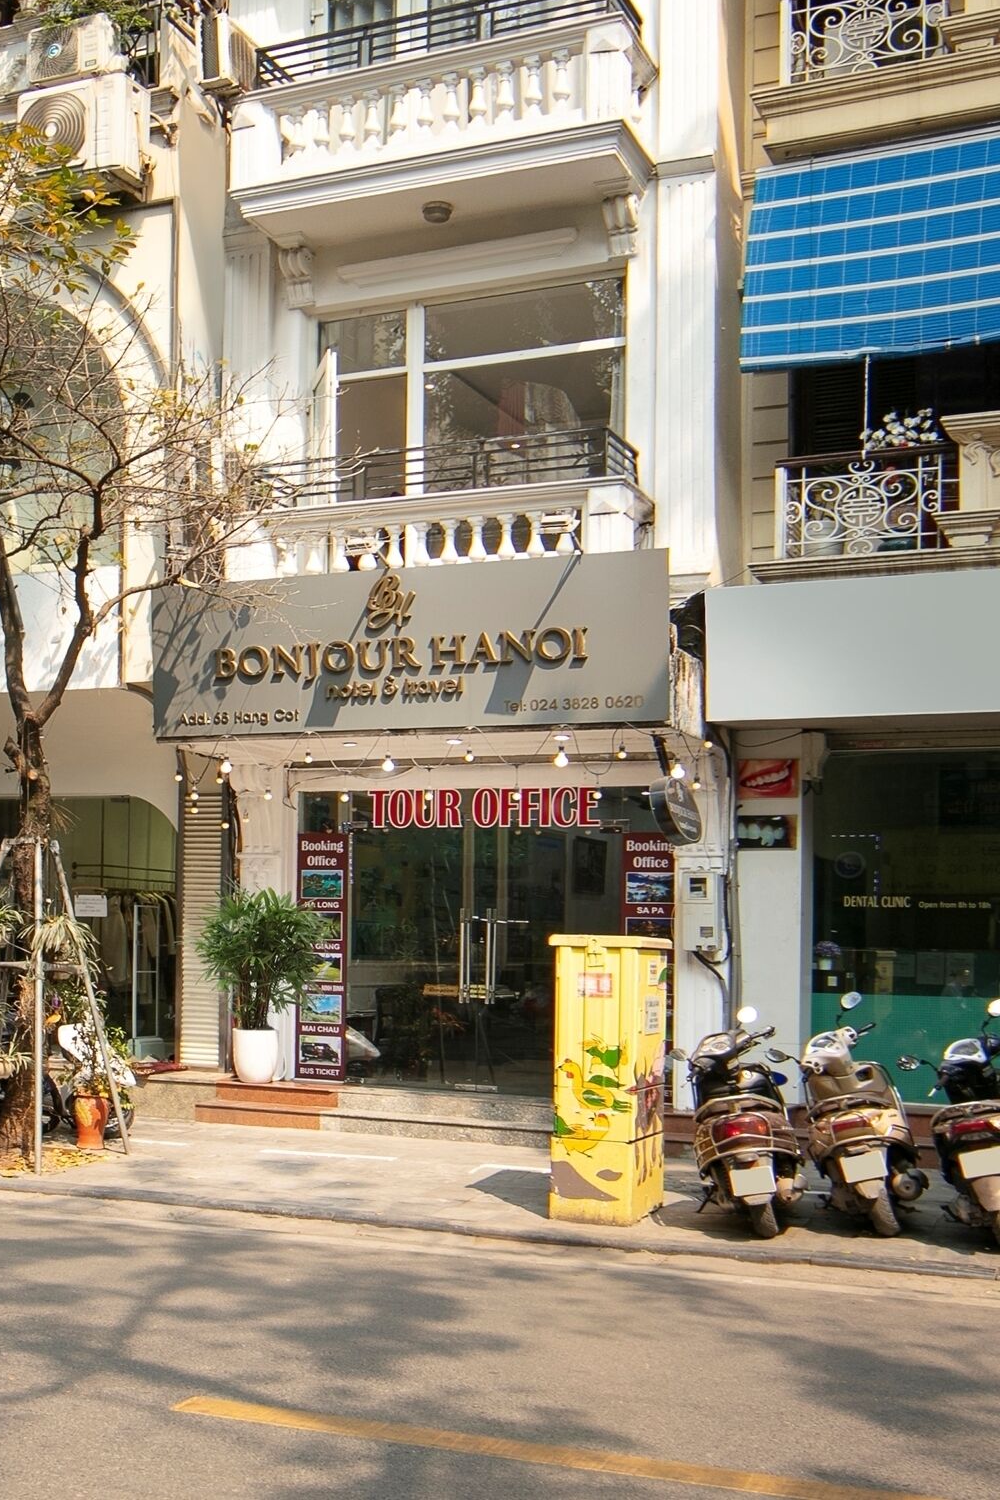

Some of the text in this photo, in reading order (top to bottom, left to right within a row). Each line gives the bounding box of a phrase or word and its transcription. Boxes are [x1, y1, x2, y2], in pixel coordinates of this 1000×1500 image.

[214, 626, 589, 681] BONJOUR HANOI
[384, 675, 398, 695] &
[403, 676, 464, 695] travel
[504, 695, 644, 712] Tel: 024 3828 0620
[234, 710, 269, 726] Hang
[274, 708, 299, 723] Cot
[368, 787, 600, 828] TOUR OFFICE
[301, 840, 344, 853] Booking
[307, 856, 337, 867] Office
[633, 856, 669, 868] Office
[843, 896, 911, 908] DENTAL CLINIC
[918, 901, 937, 909] Open
[939, 901, 957, 909] from
[636, 906, 664, 914] SA PA
[317, 1025, 340, 1033] CHAU
[300, 1067, 340, 1076] BUS TICKET
